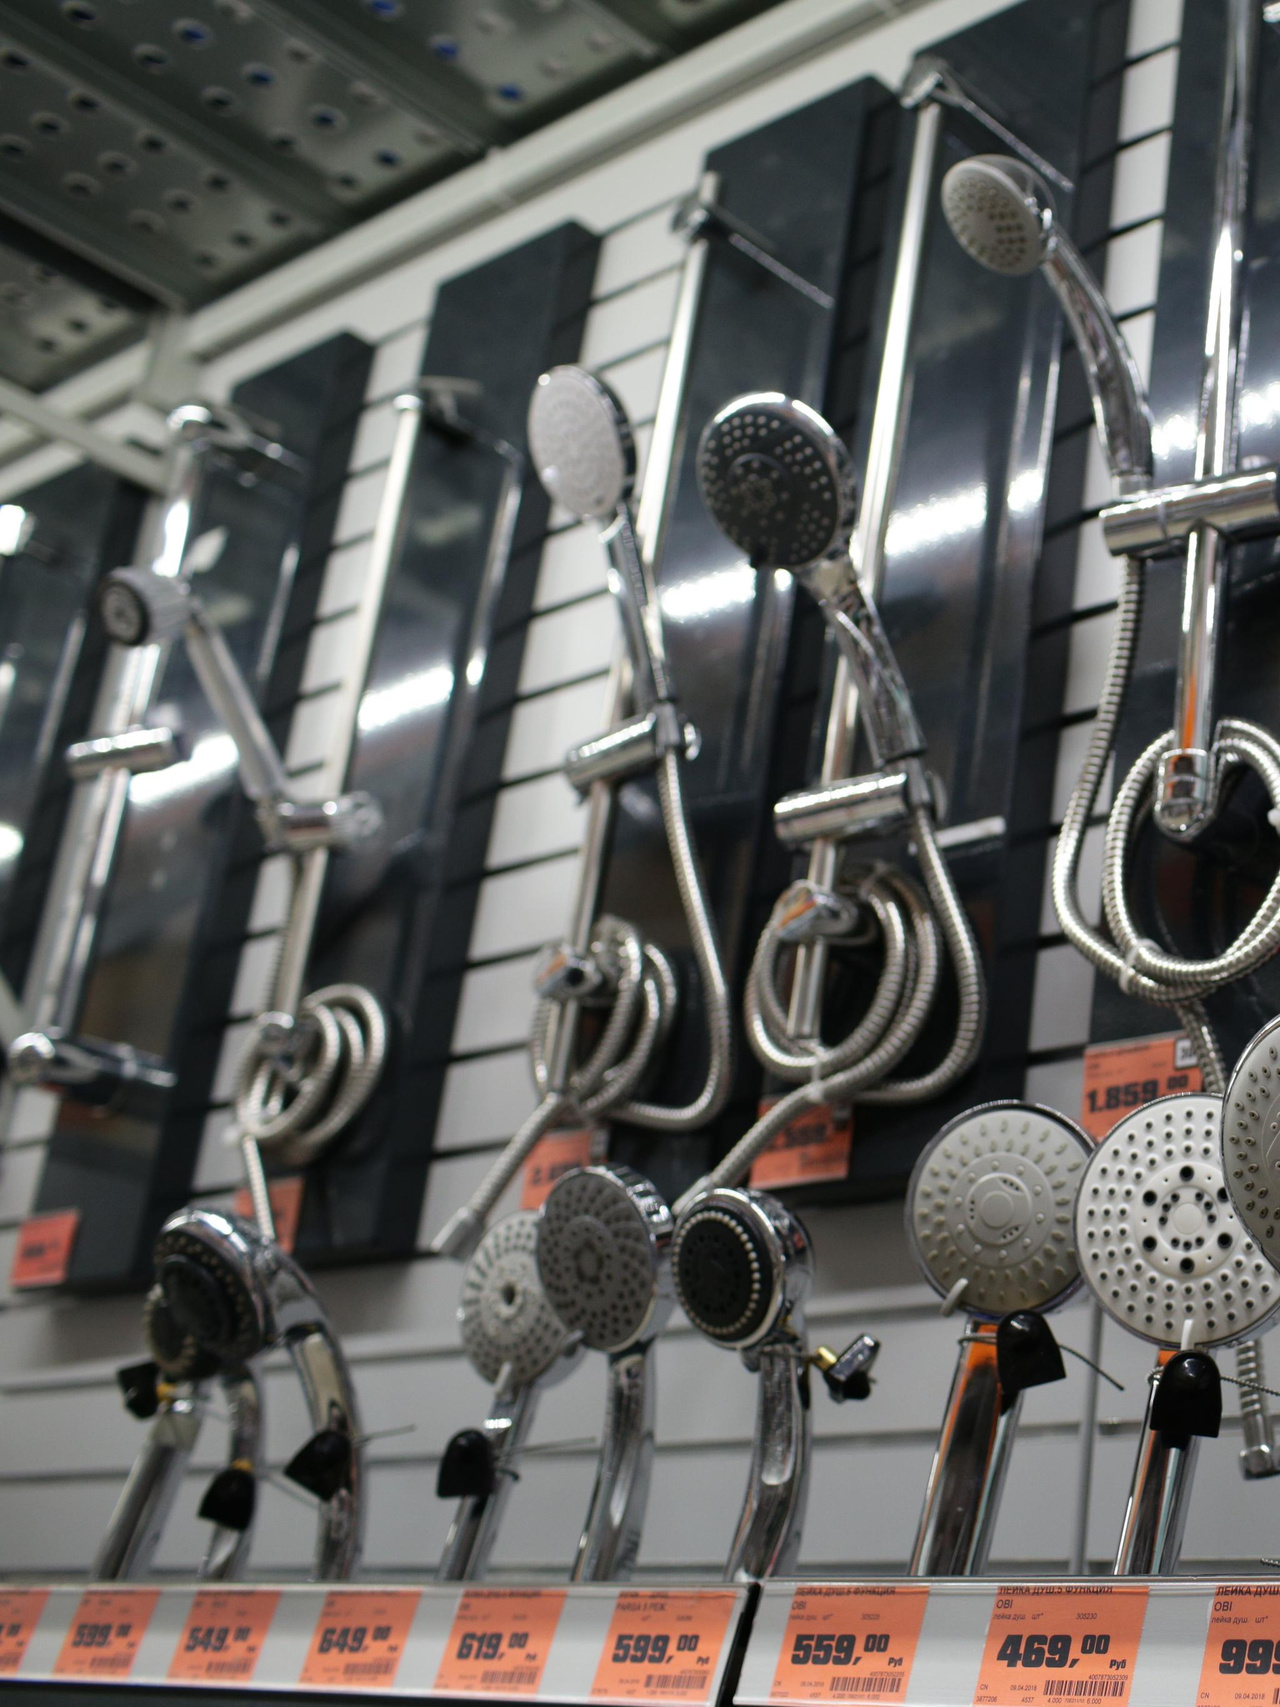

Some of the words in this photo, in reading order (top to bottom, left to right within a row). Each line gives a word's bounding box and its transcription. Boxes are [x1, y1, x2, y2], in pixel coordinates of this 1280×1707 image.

[996, 1599, 1013, 1609] OBI
[1214, 1601, 1233, 1611] OBI
[612, 1634, 700, 1664] 599,00
[791, 1634, 890, 1665] 559,00
[996, 1634, 1111, 1668] 469,00
[1109, 1659, 1127, 1671] Руб
